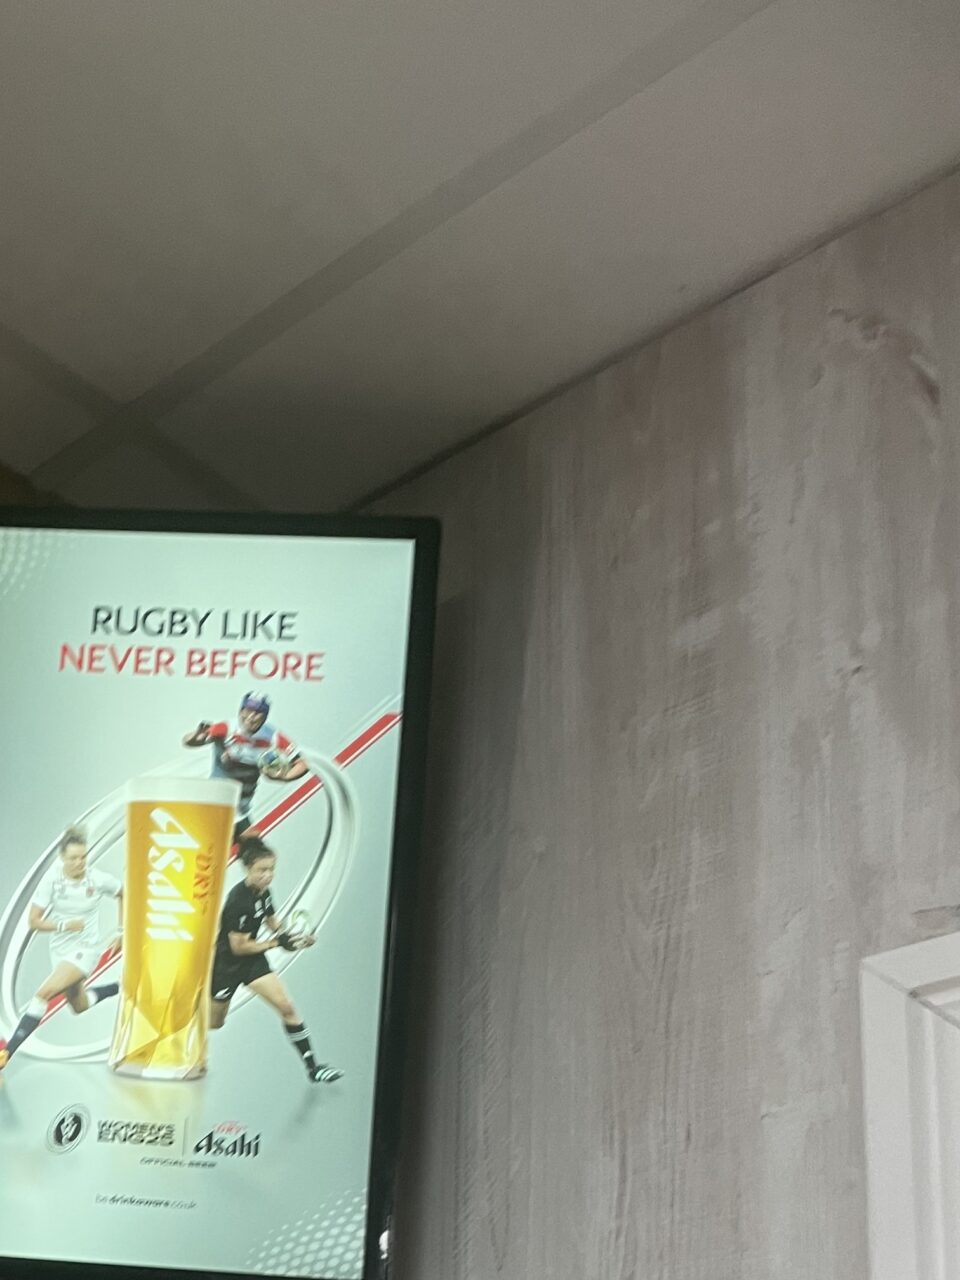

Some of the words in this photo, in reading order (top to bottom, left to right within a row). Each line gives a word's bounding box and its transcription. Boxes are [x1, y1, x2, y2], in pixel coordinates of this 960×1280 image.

[90, 605, 213, 639] RUGBY
[220, 609, 298, 641] LIKE
[58, 643, 175, 677] NEVER
[185, 647, 326, 682] BEFORE
[146, 807, 200, 941] Asahi
[193, 1130, 261, 1158] Asahi
